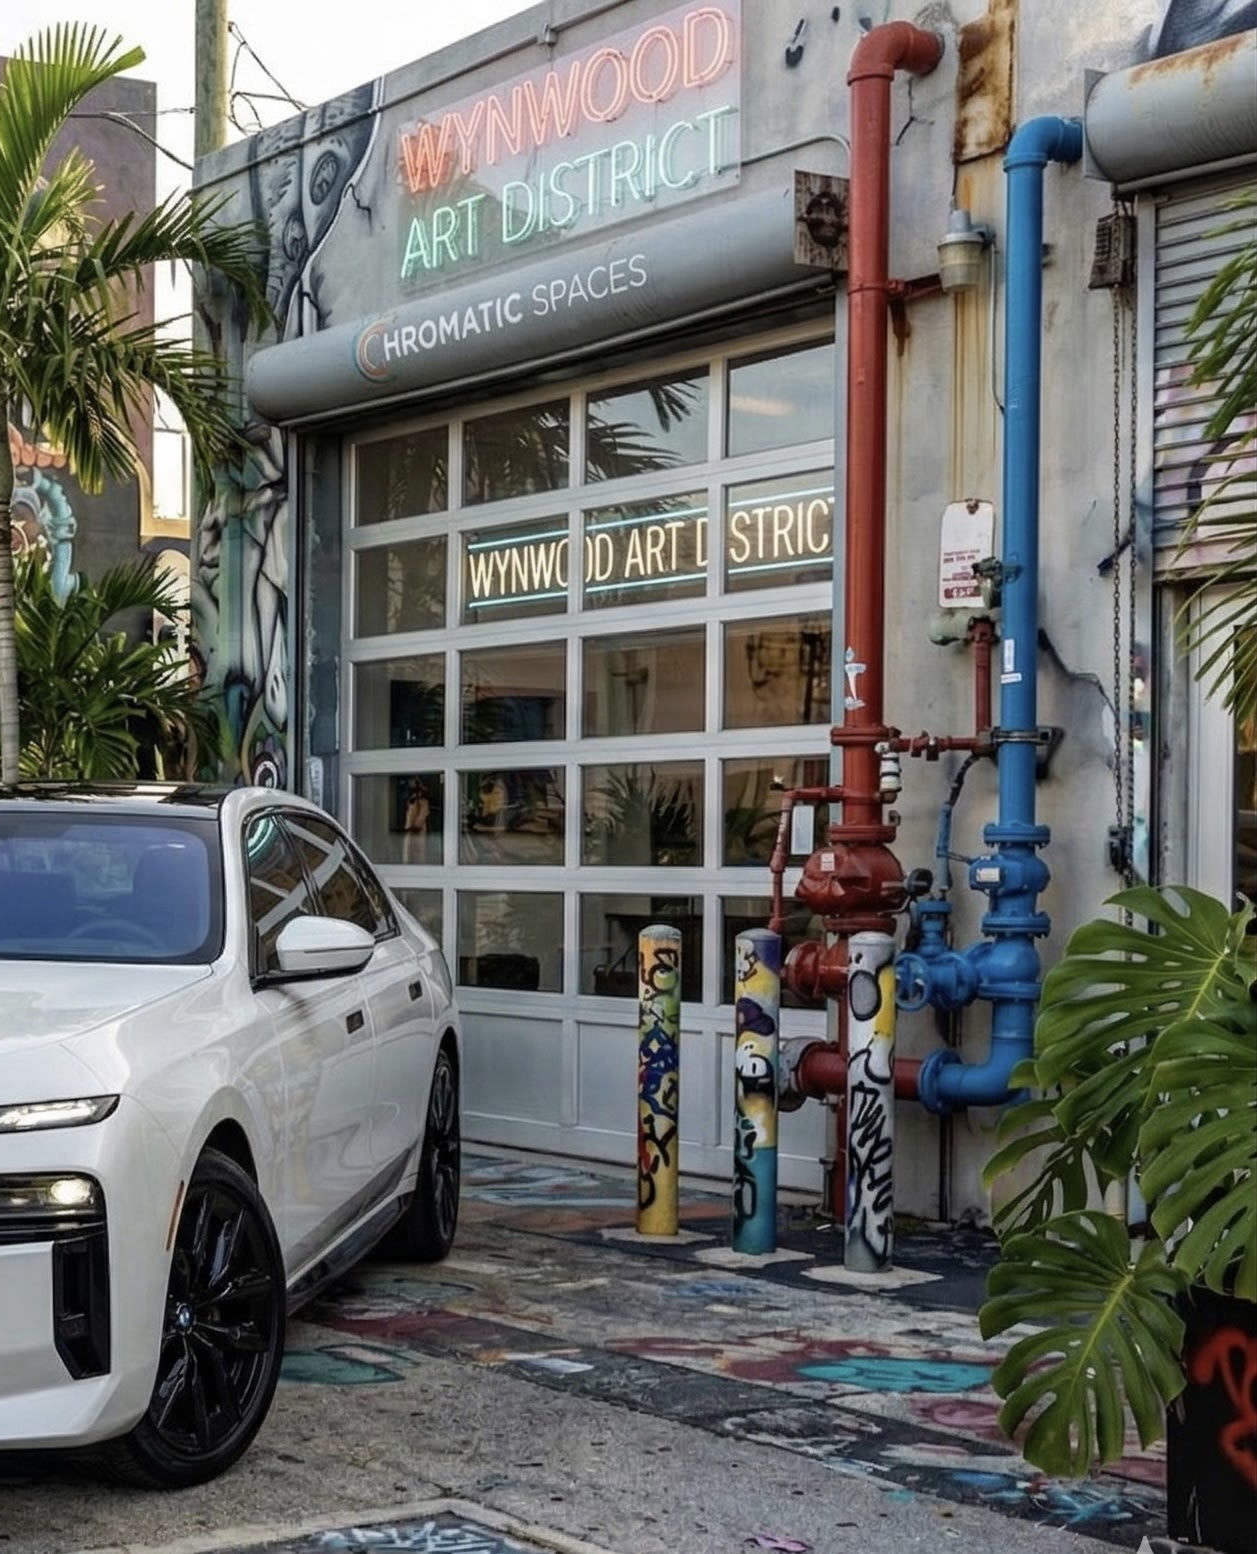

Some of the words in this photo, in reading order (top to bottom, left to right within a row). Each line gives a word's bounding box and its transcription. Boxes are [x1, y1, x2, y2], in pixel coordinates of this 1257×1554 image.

[400, 7, 730, 193] WYNWOOD
[401, 194, 485, 279] ART
[502, 105, 735, 244] DISTRICT
[353, 293, 523, 382] CHROMATIC
[532, 254, 647, 316] SPACES
[625, 522, 685, 578] ART
[696, 496, 835, 567] DSTRIC
